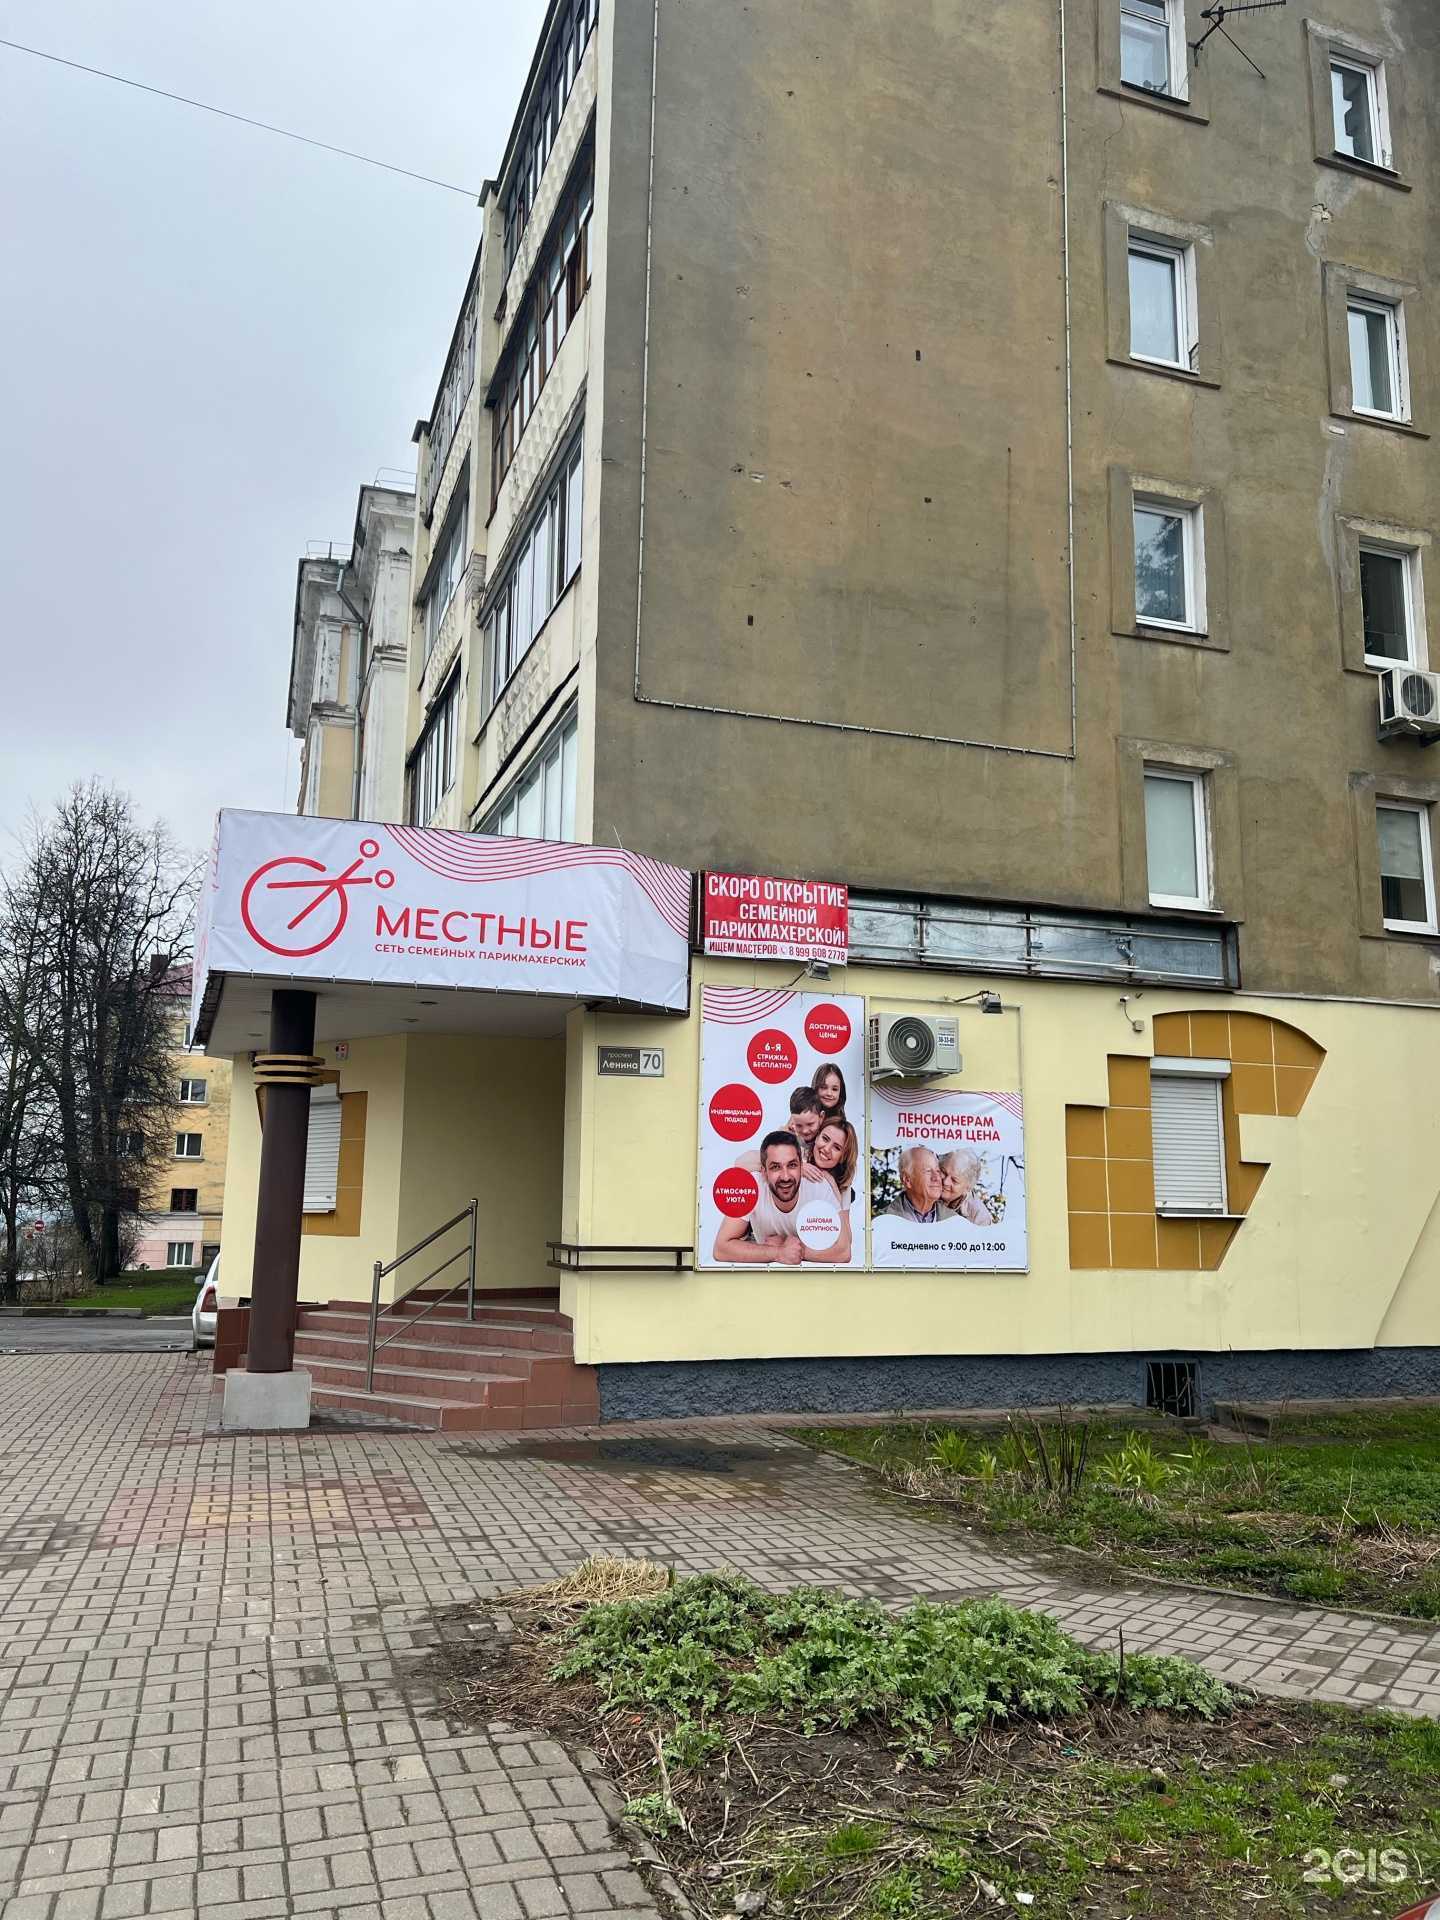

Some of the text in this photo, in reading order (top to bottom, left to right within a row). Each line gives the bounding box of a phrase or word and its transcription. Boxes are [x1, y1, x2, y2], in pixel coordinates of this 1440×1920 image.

[708, 875, 846, 908] СКОРО ОТКРЫТИЕ
[739, 903, 817, 925] СЕМЕЙНОЙ
[375, 904, 588, 952] МЕСТНЫЕ
[709, 919, 846, 947] ПАРИКМАХЕРСКОЙ!
[375, 943, 587, 967] СЕТЬ СЕМЕЙНЫХ ПАРИКМАХЕРСКИХ
[709, 941, 735, 954] ИЩЕМ
[736, 943, 778, 955] МАСТЕРОВ
[788, 945, 794, 956] 8
[795, 947, 810, 958] 999
[828, 949, 846, 961] 2778
[808, 1022, 848, 1032] ДОСТУПНЫЕ
[819, 1031, 838, 1039] ЦЕНЫ
[764, 1042, 782, 1052] 6-Я
[643, 1053, 661, 1070] 70
[756, 1053, 789, 1061] СТРИЖКА
[602, 1060, 638, 1070] Ленина
[752, 1062, 793, 1070] БЕСПЛАТНО
[710, 1108, 762, 1116] ИНДИВИДУАЛЬНЫЙ
[724, 1116, 748, 1124] ПОДХОД
[898, 1112, 994, 1128] ПЕНСИОНЕРАМ
[896, 1126, 1001, 1142] ЛЬГОТНАЯ ЦЕНА
[715, 1187, 757, 1196] АТМОСФЕРА
[726, 1196, 746, 1204] УЮТА
[891, 1241, 1006, 1252] Ежедневно с 9:00 до 12:00
